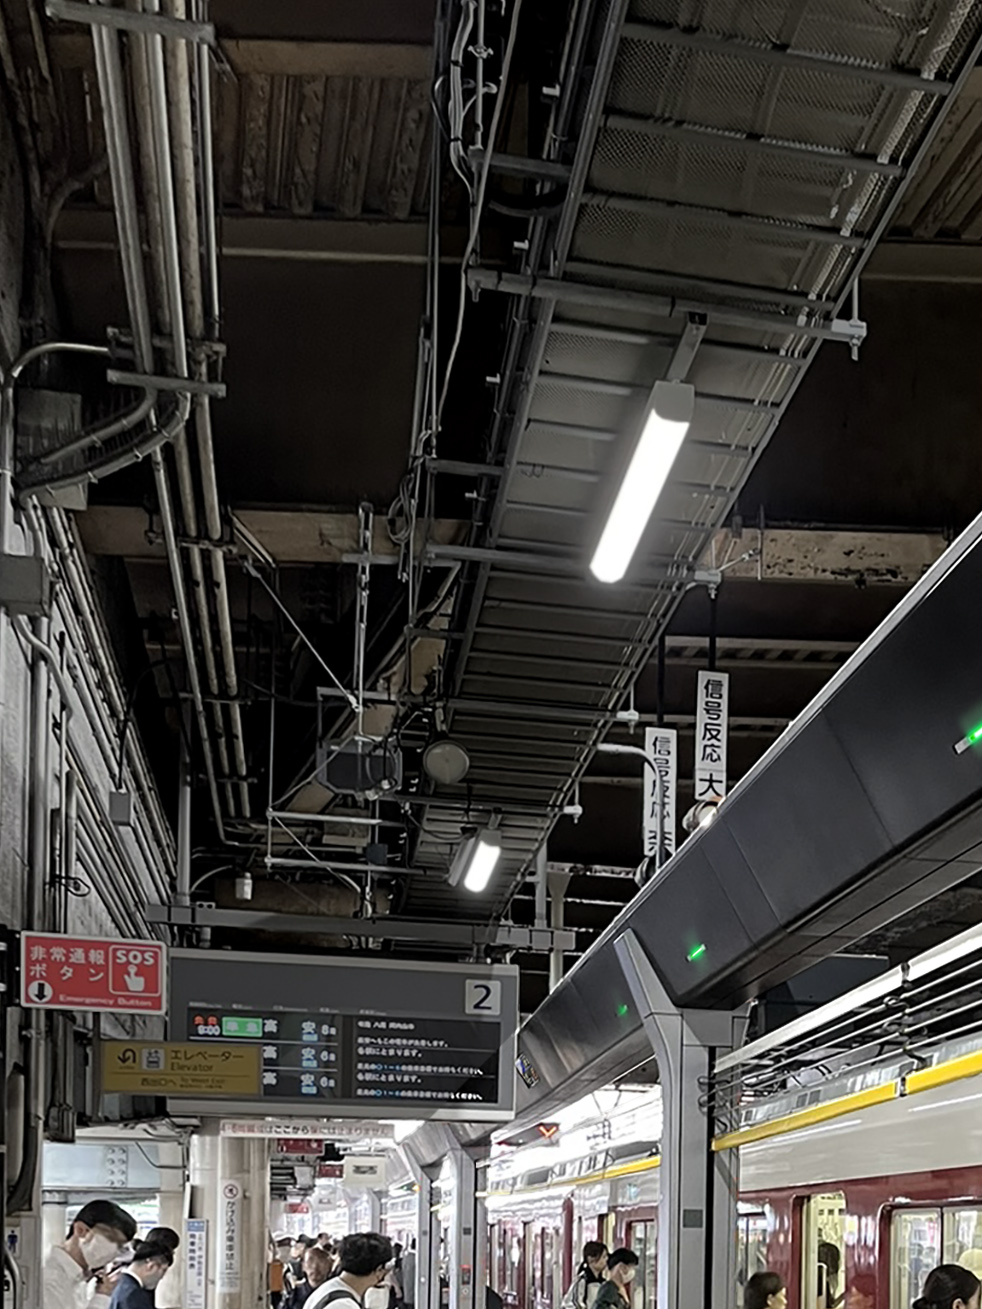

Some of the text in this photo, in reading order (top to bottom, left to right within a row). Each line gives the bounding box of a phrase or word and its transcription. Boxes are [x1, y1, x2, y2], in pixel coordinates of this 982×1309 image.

[30, 945, 105, 965] 非常通報
[116, 950, 155, 965] SOS
[30, 963, 104, 981] ボタン
[59, 994, 152, 1007] Emergency Button
[473, 984, 492, 1010] 2
[170, 1049, 244, 1062] エレベーター
[170, 1062, 213, 1073] Elevator
